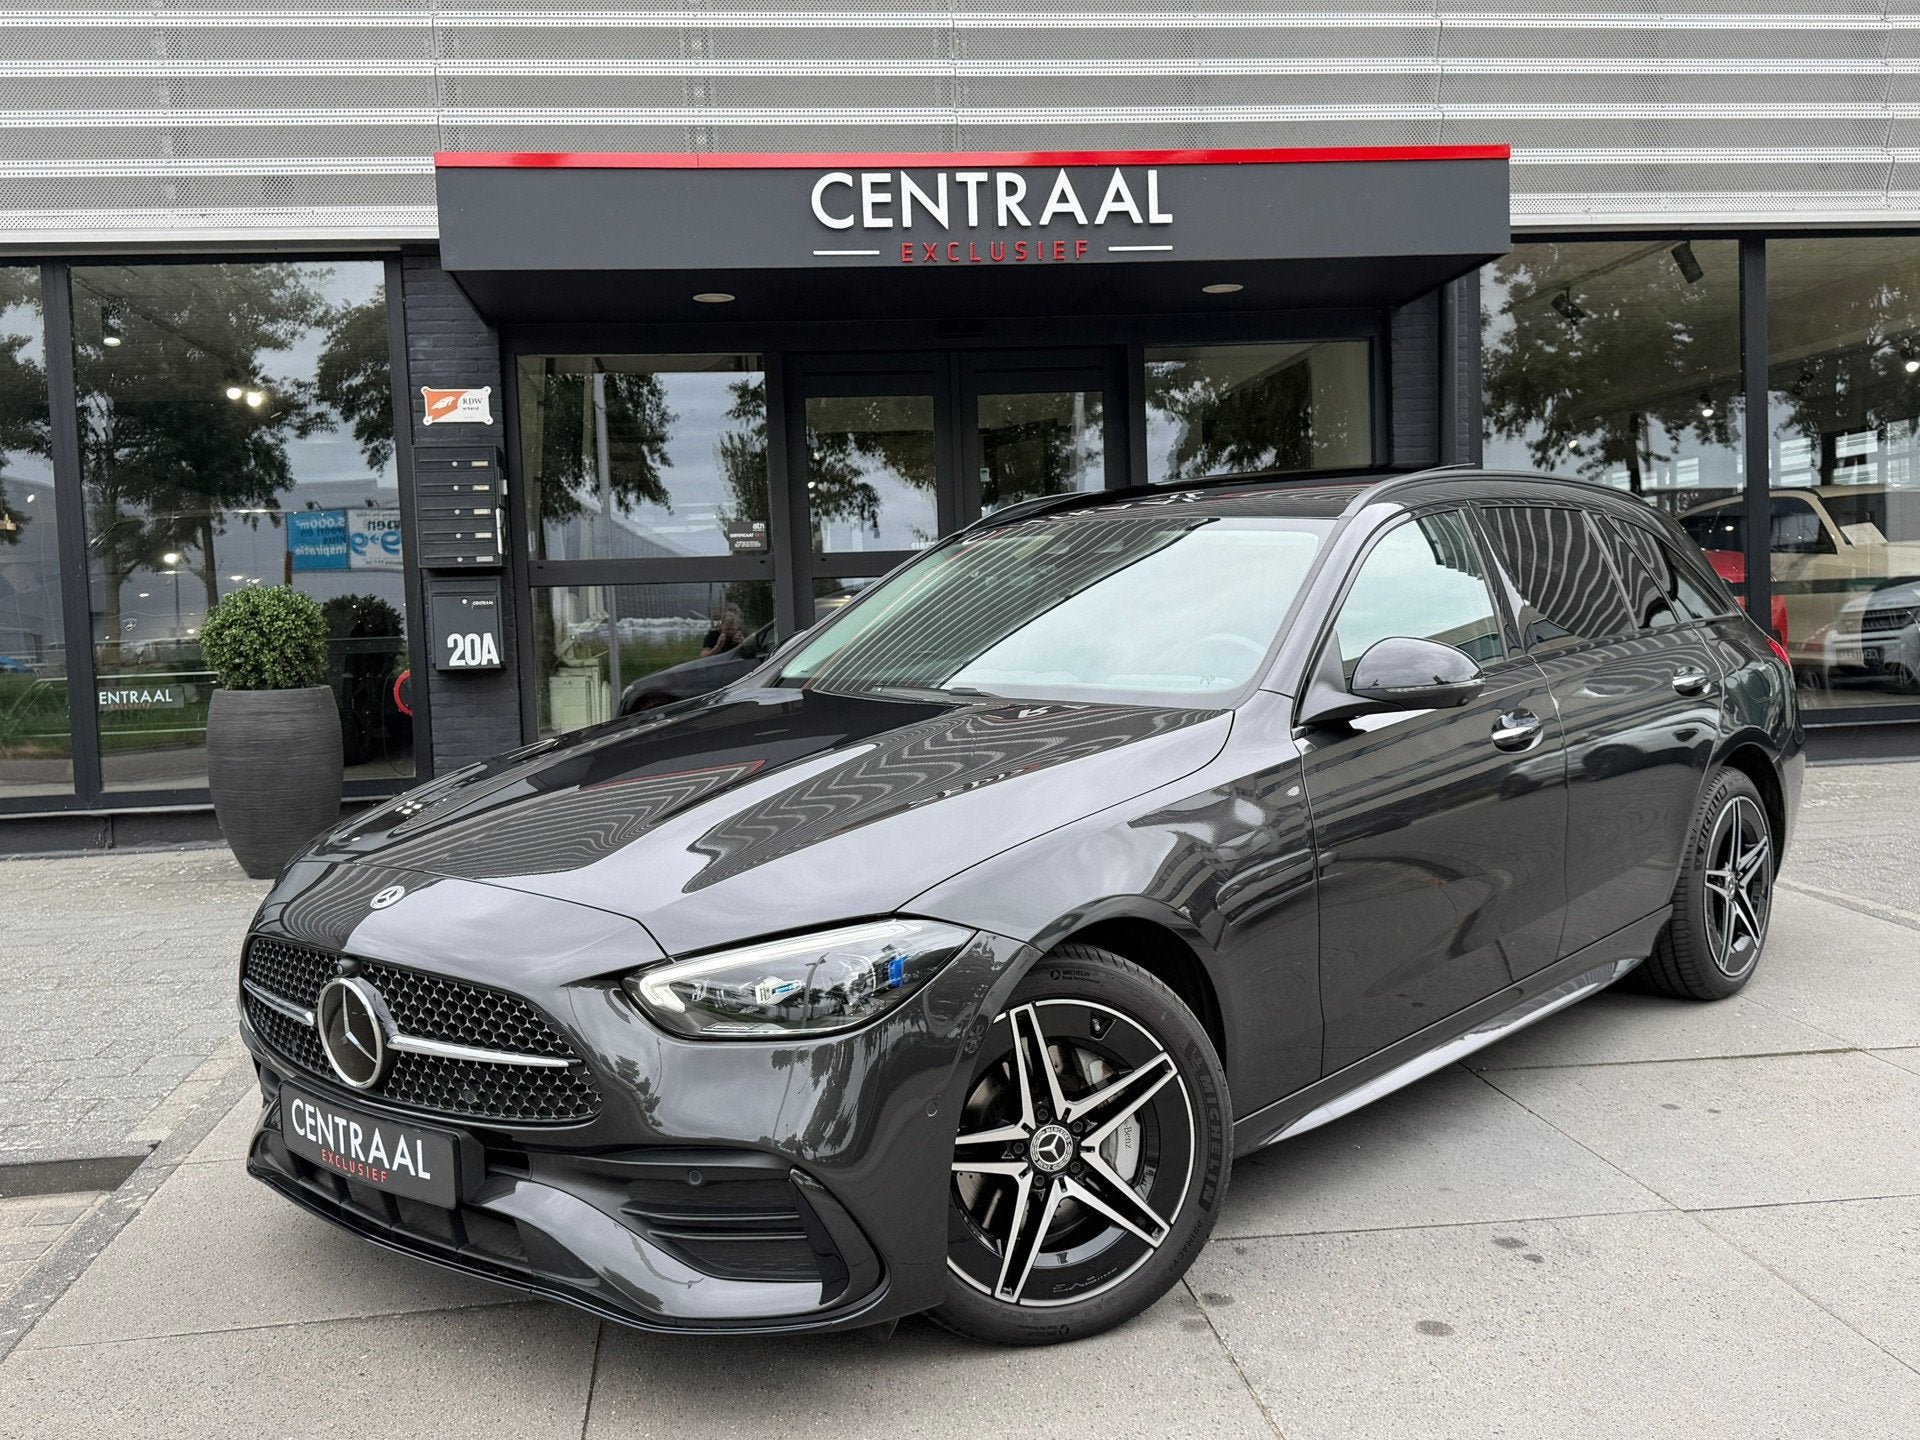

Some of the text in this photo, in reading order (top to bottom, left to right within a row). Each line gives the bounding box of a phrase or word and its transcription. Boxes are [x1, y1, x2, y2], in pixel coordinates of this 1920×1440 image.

[811, 167, 1173, 231] CENTRAAL
[901, 240, 1089, 263] EXCLUSIEF
[447, 632, 500, 667] 20A
[98, 689, 173, 705] ENTRAAL
[291, 1098, 431, 1180] CENTRAAL
[1200, 1073, 1223, 1204] MICHELIN
[321, 1148, 388, 1184] EXCLUSIEF
